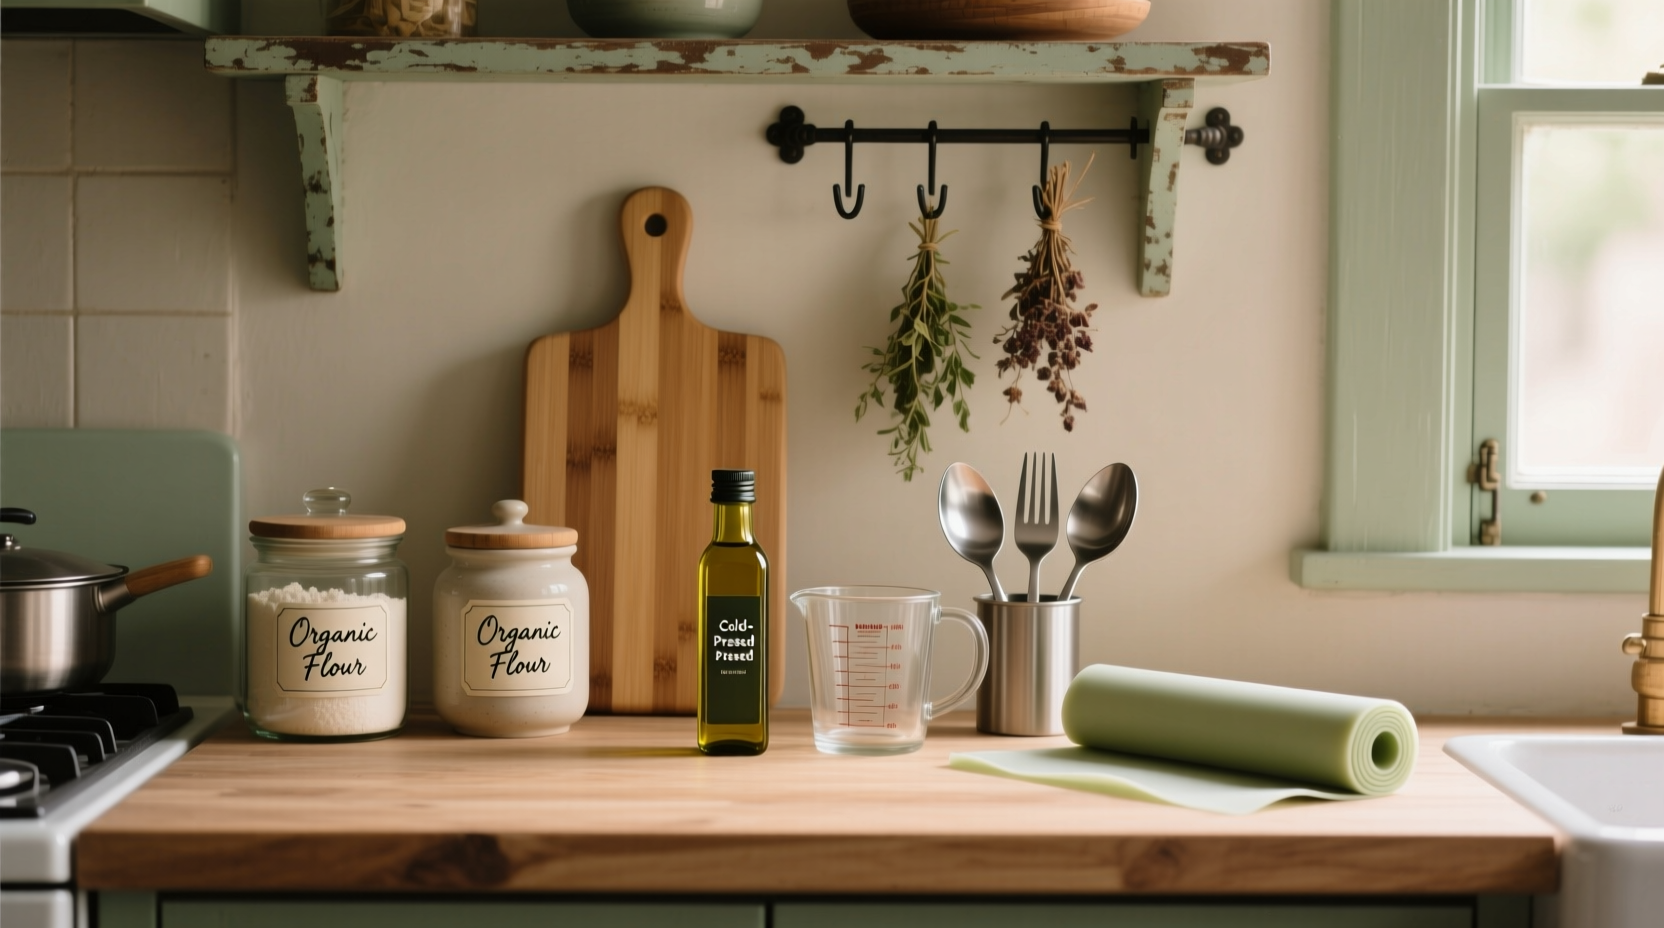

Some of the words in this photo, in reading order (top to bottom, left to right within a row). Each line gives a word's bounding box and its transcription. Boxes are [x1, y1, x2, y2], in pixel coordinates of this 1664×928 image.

[289, 616, 377, 654] Organic
[477, 614, 561, 653] Organic
[719, 618, 754, 632] Cold-
[303, 651, 367, 681] Flour
[490, 649, 551, 680] Flour
